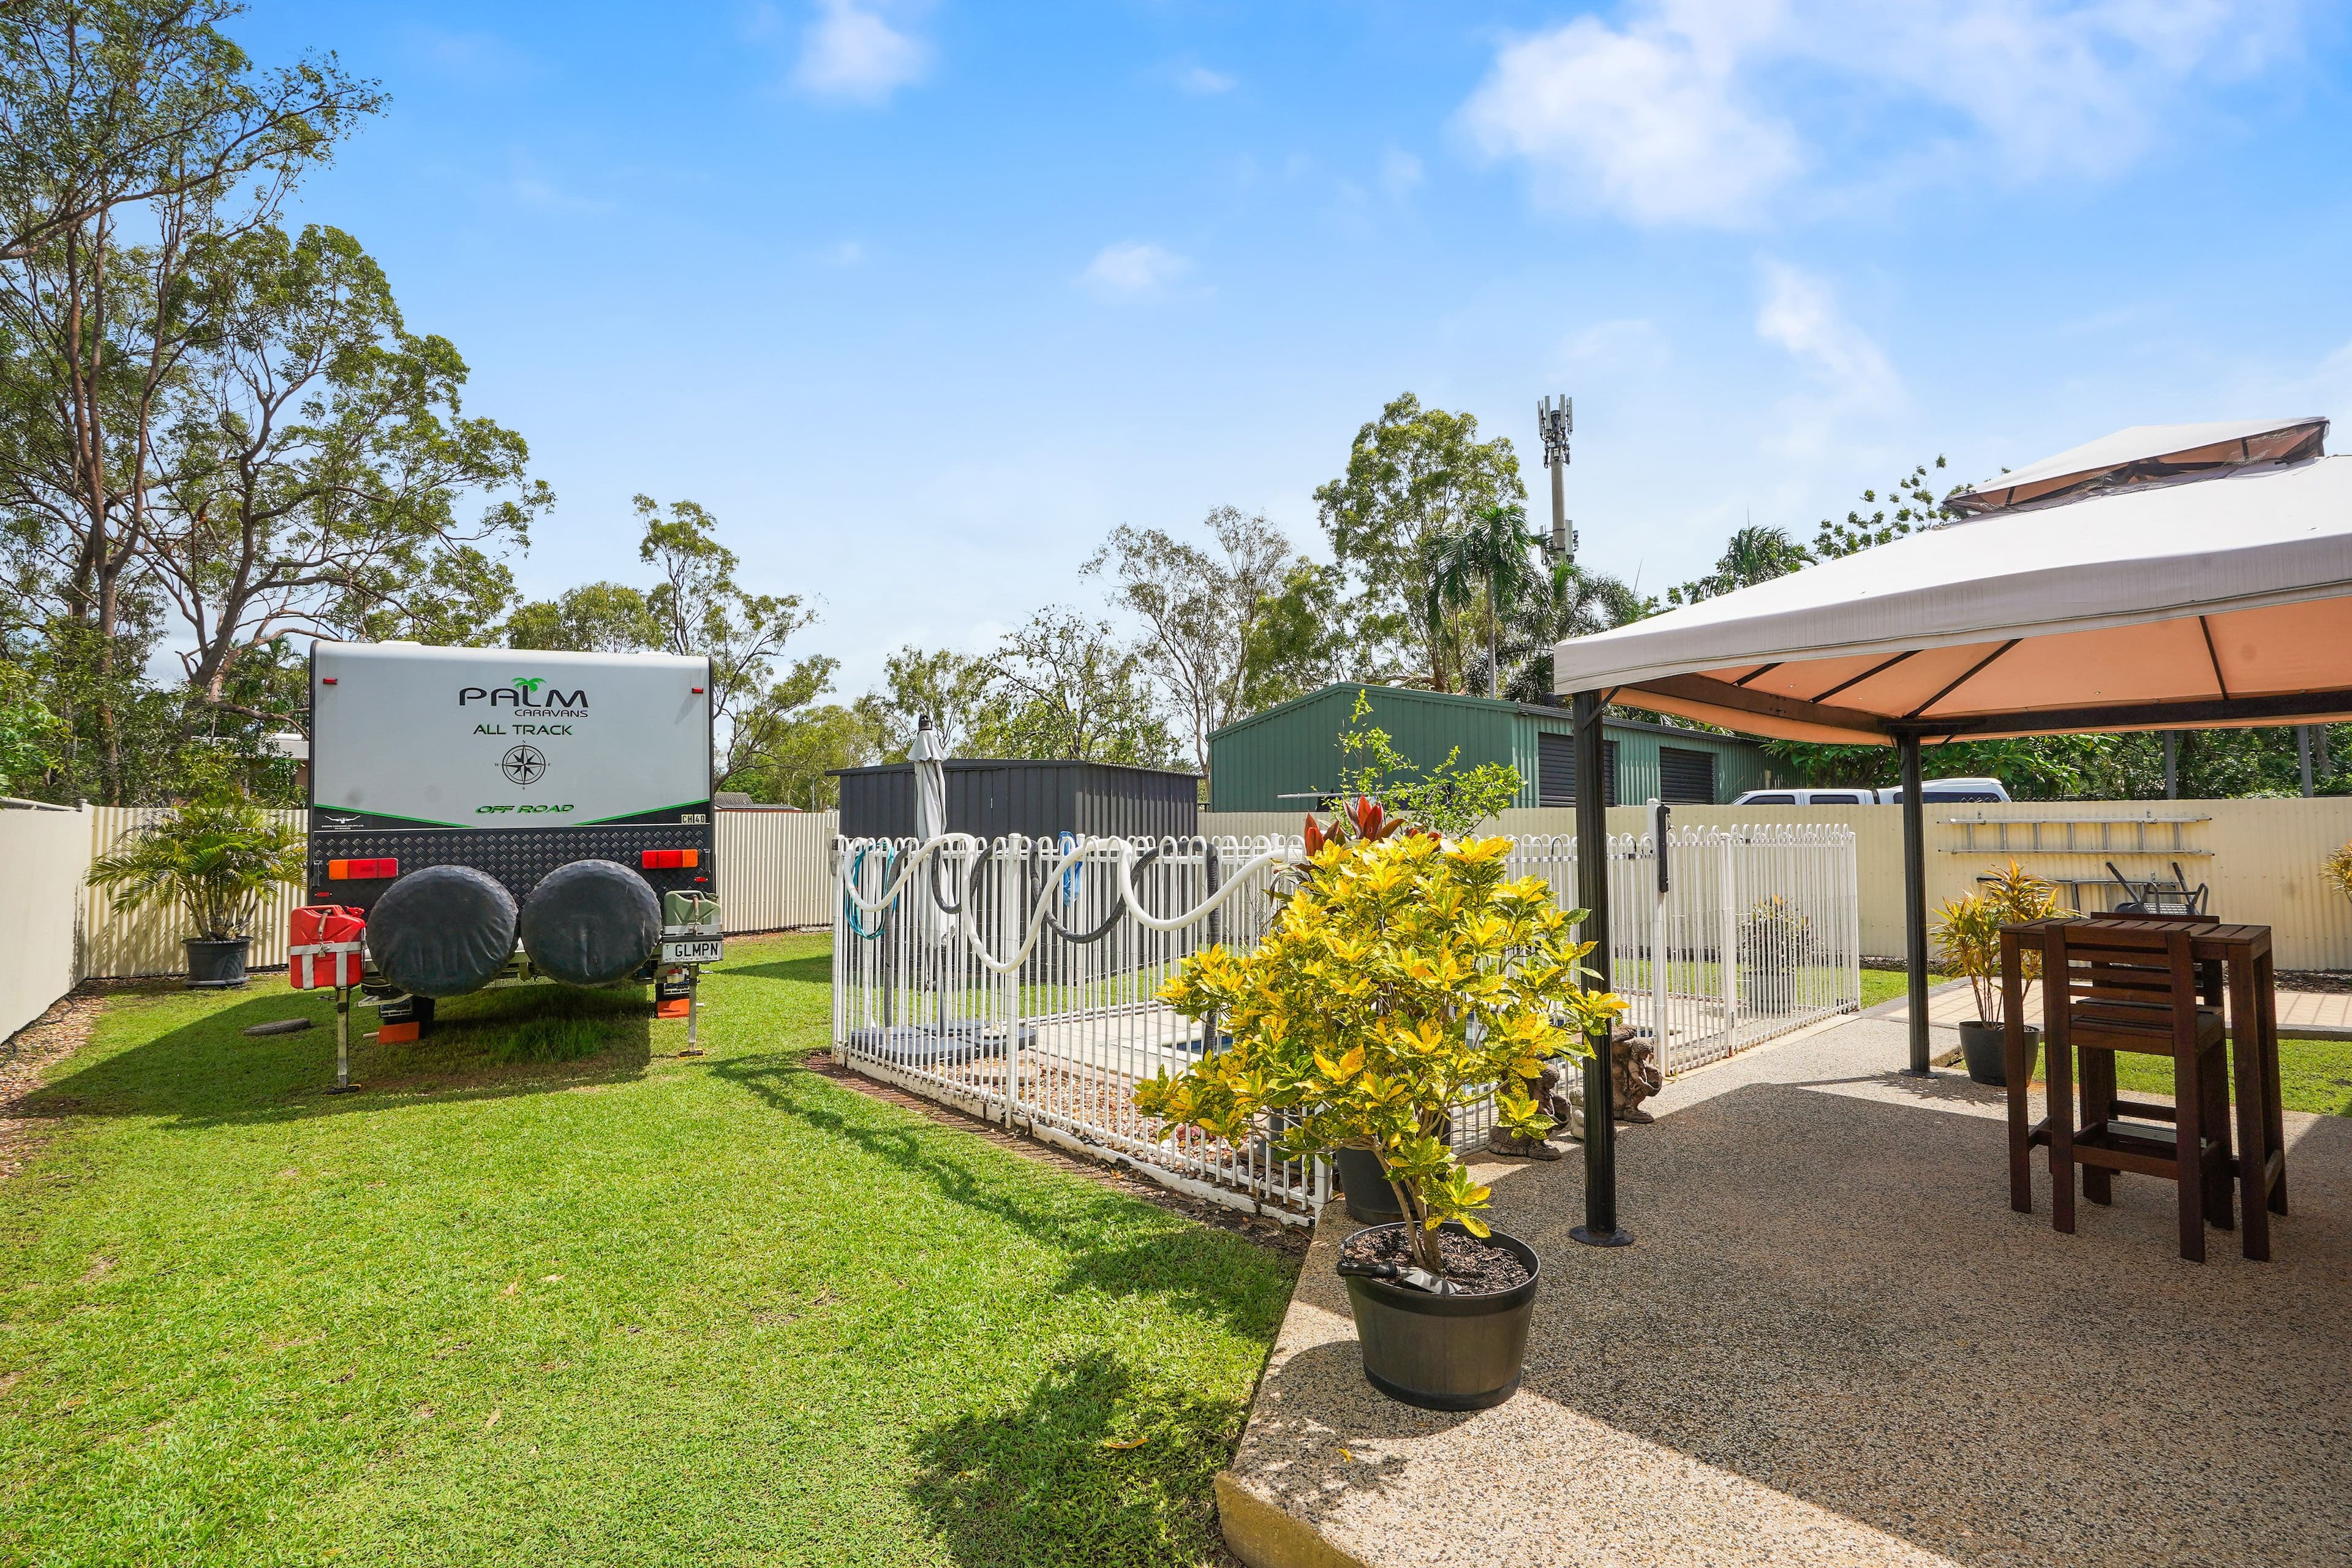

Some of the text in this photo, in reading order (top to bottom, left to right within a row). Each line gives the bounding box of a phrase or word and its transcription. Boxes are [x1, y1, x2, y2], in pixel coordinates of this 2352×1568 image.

[459, 685, 589, 707] PALM
[473, 725, 573, 735] ALL TRACK
[475, 804, 575, 814] OFF ROAD
[675, 943, 718, 957] GLMPN
